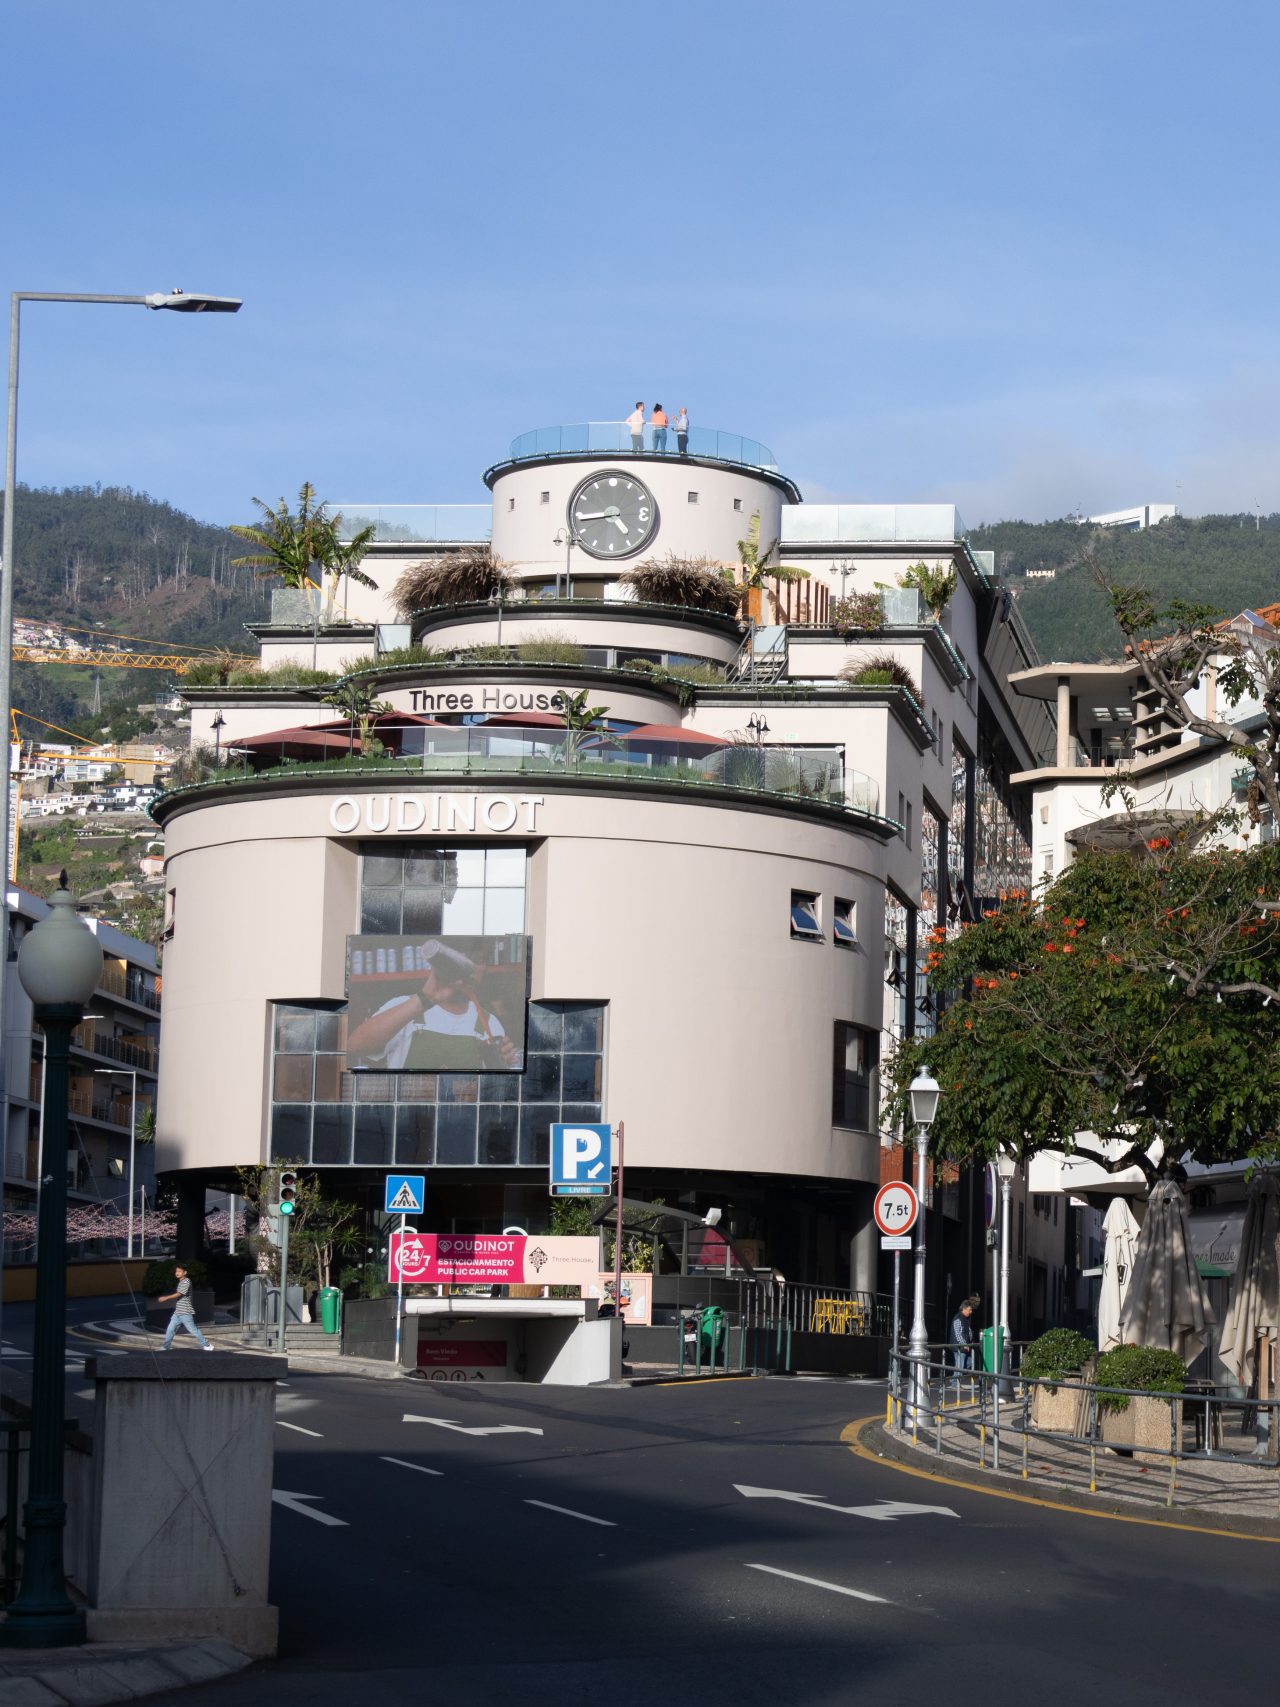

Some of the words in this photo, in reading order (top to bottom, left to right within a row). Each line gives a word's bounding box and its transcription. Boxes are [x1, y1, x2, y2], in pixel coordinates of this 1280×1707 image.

[409, 689, 473, 711] Three
[329, 796, 544, 833] OUDINOT
[563, 1129, 601, 1179] P
[568, 1186, 592, 1194] LIVRE
[884, 1203, 908, 1219] 7.5t
[454, 1240, 514, 1252] OUDINOT
[438, 1258, 514, 1267] ESTACIONAMENTO
[437, 1268, 469, 1276] PUBLIC
[469, 1268, 486, 1276] CAR
[487, 1268, 508, 1276] PARK
